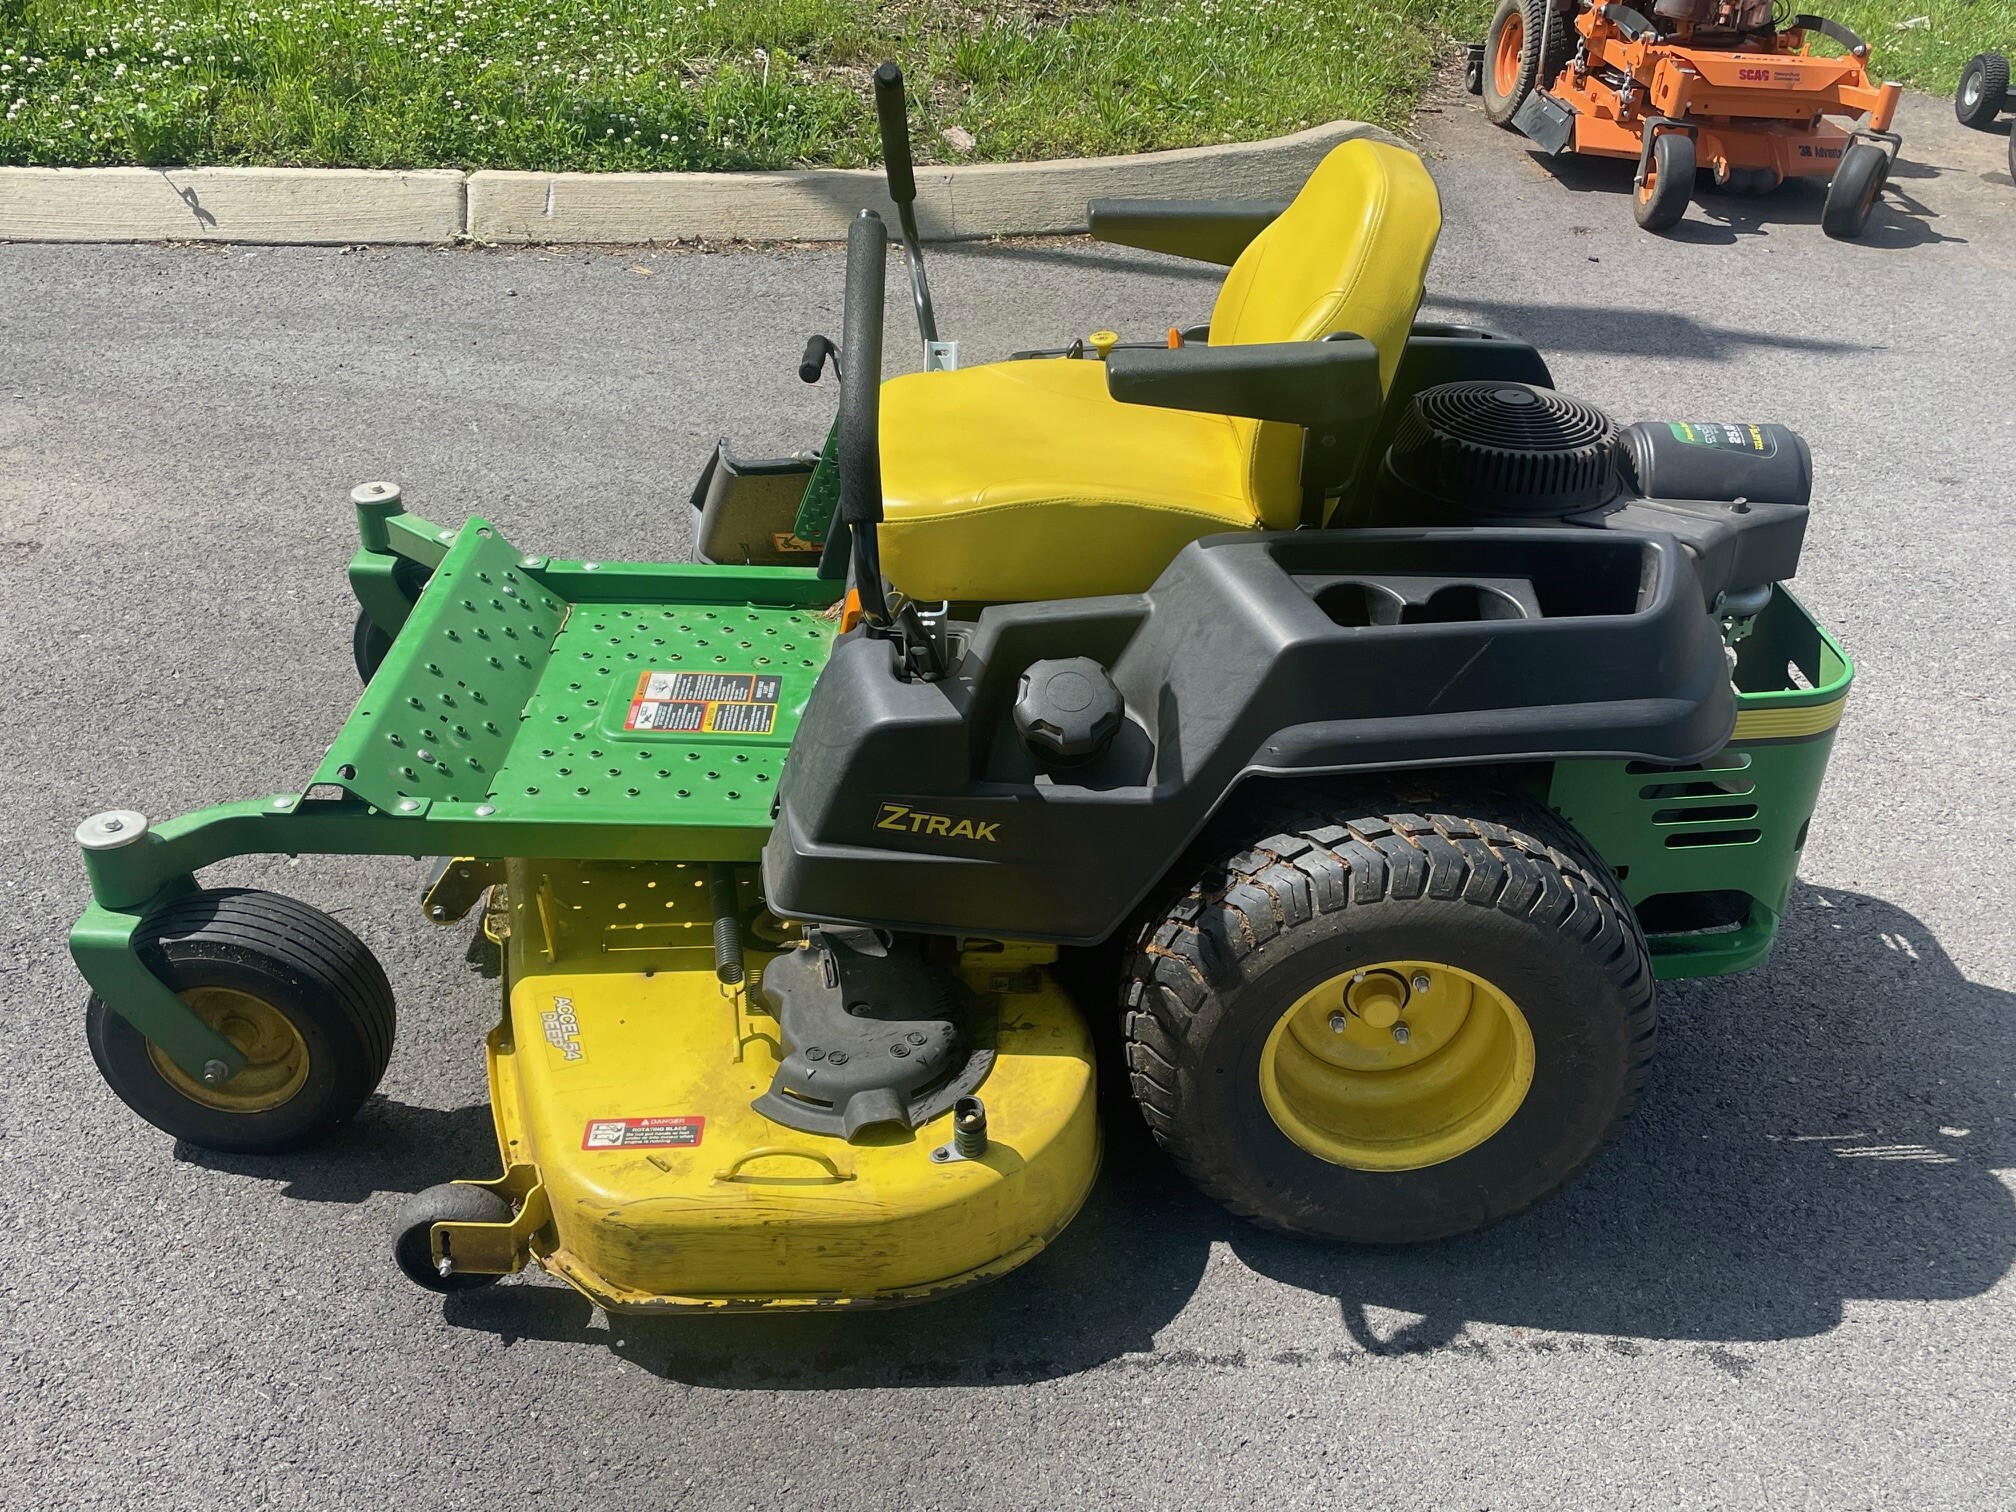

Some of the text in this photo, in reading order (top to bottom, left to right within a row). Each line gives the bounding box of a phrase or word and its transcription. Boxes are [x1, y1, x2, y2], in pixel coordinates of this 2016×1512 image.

[1738, 69, 1769, 81] SCAG
[877, 805, 1001, 842] ZTRAK
[541, 1010, 563, 1048] DEEP
[553, 995, 580, 1042] ACCEL
